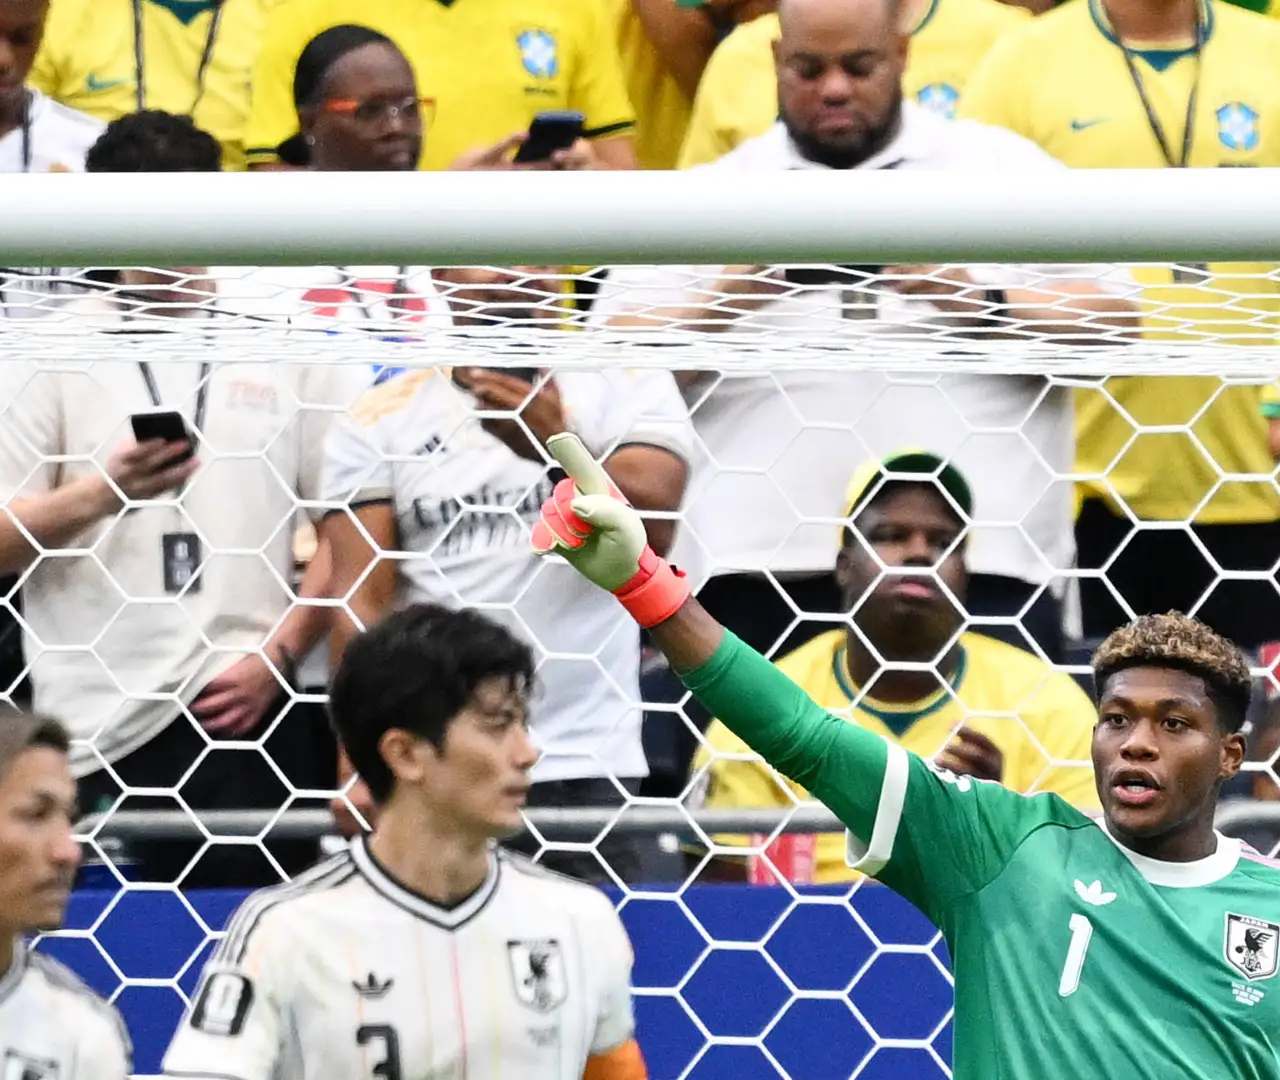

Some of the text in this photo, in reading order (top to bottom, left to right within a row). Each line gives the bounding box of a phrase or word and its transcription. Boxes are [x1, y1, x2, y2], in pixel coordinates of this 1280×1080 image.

[1240, 917, 1269, 929] JAPAN
[1058, 912, 1093, 997] 1
[1240, 956, 1263, 971] JFA
